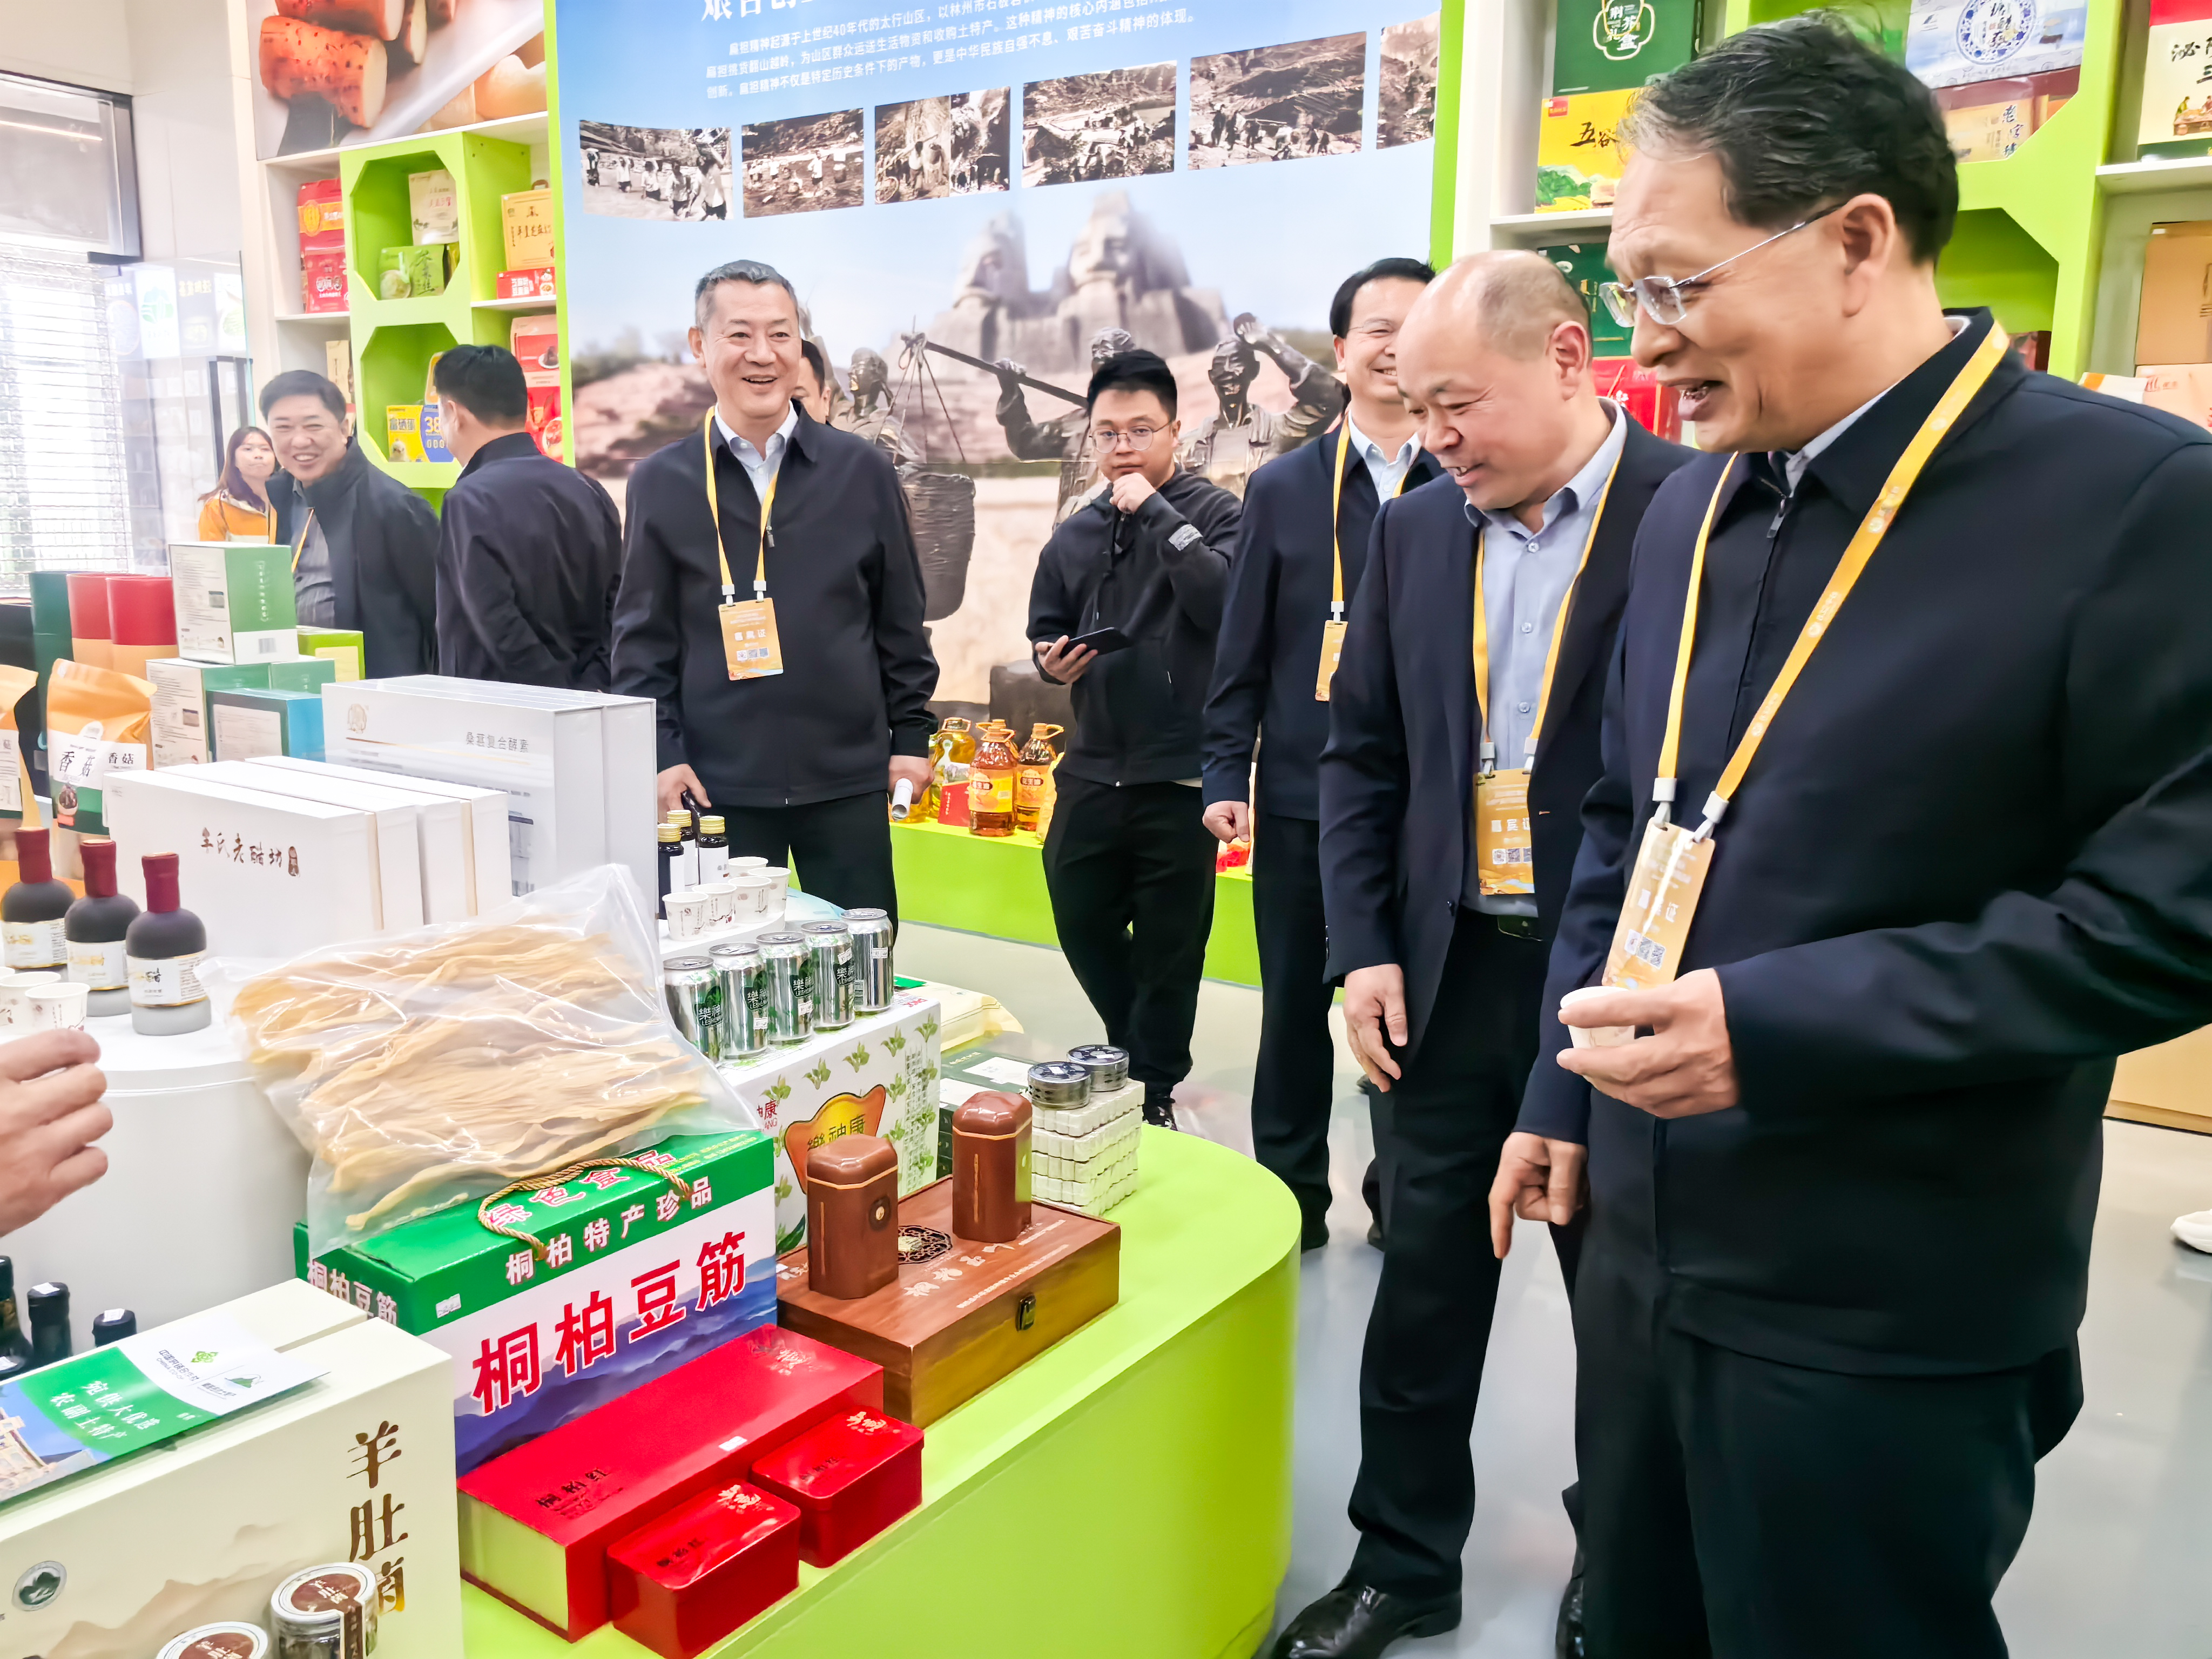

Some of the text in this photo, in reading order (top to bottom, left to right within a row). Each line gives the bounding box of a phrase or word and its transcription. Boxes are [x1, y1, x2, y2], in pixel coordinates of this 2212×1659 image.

[109, 752, 134, 765] 香菇
[505, 1176, 712, 1285] 桐柏特产珍品
[307, 1260, 397, 1326] 桐柏豆筋
[471, 1229, 747, 1417] 桐柏豆筋
